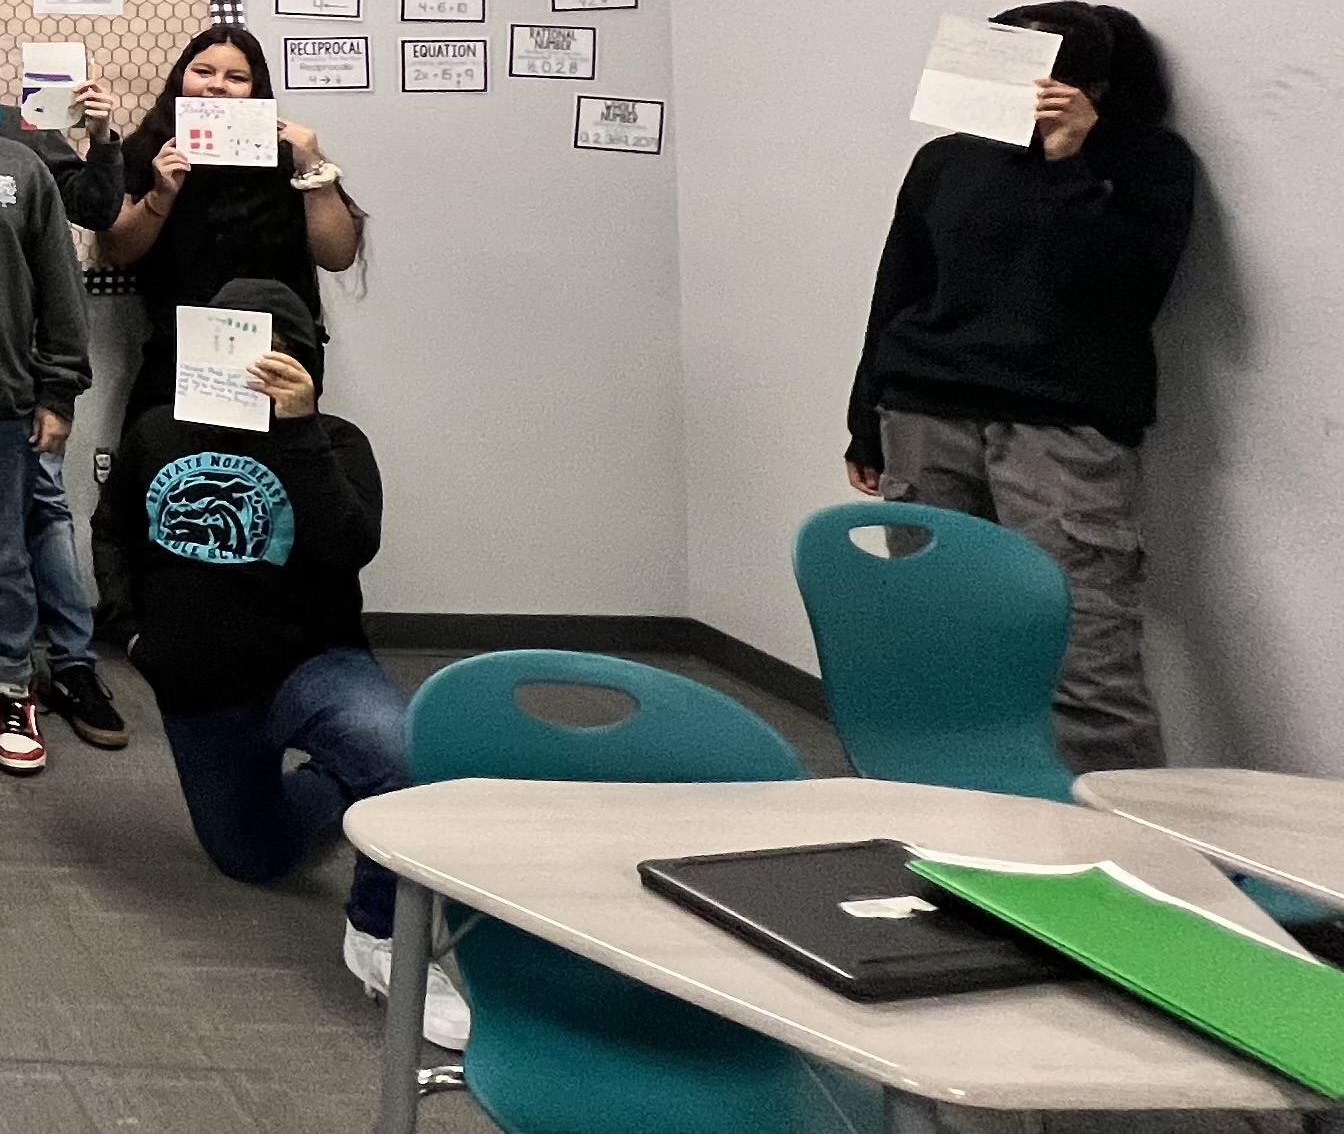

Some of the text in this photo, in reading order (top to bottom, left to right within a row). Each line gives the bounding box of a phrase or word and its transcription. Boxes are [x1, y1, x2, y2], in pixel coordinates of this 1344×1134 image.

[529, 26, 577, 41] RATIONAL
[289, 41, 363, 56] RECIPROCAL
[413, 43, 477, 58] EQUATION
[534, 38, 572, 51] NUMBER
[600, 111, 640, 124] NUMBER
[148, 457, 203, 504] ELEVATE
